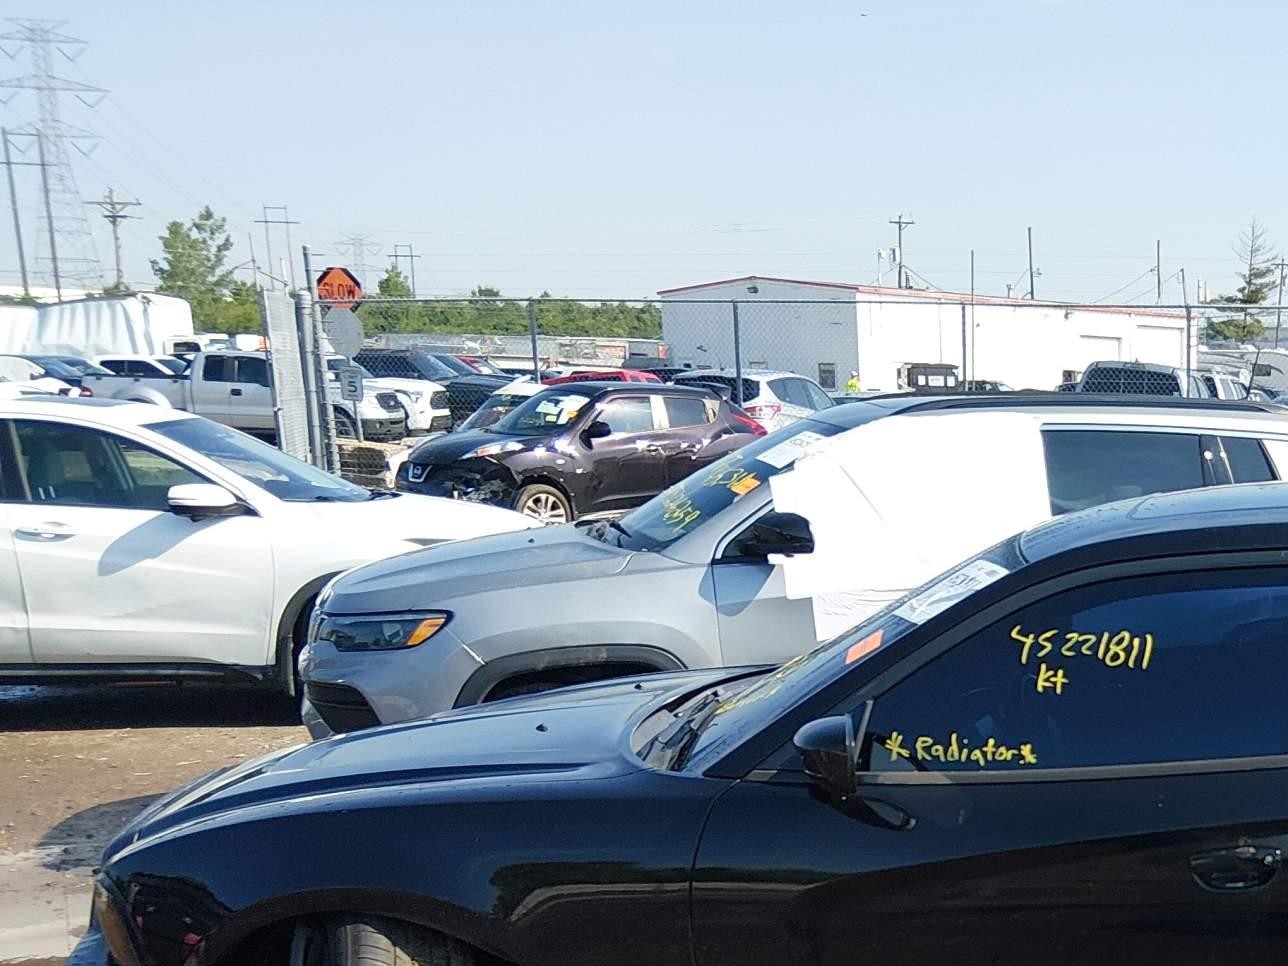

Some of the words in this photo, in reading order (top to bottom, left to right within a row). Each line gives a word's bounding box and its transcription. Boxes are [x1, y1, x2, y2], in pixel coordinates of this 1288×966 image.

[320, 281, 356, 299] SLOW
[347, 380, 358, 393] 5
[1010, 624, 1154, 670] 45221811
